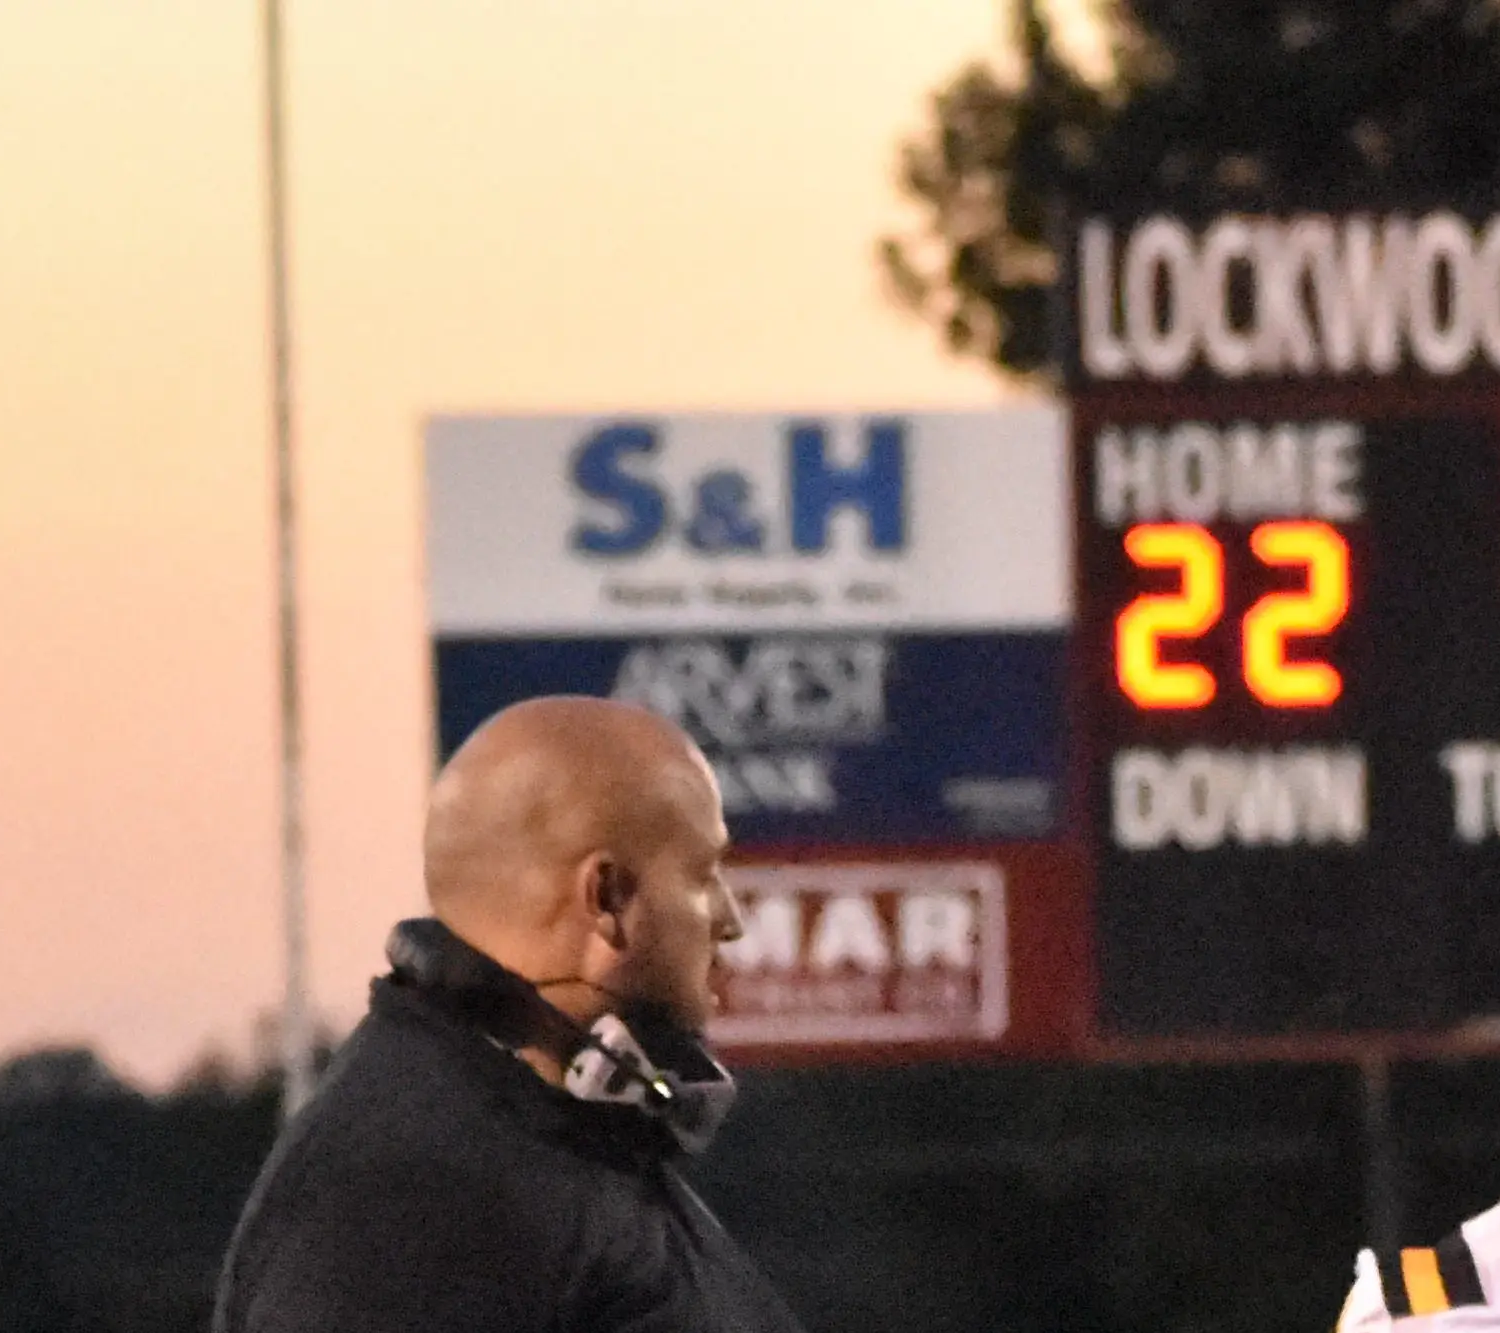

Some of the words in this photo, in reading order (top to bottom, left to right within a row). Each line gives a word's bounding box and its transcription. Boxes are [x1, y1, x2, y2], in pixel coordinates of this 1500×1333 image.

[569, 422, 909, 556] S&H
[1095, 420, 1365, 525] HOME
[1115, 520, 1351, 708] 22
[1110, 744, 1368, 852] DOWN
